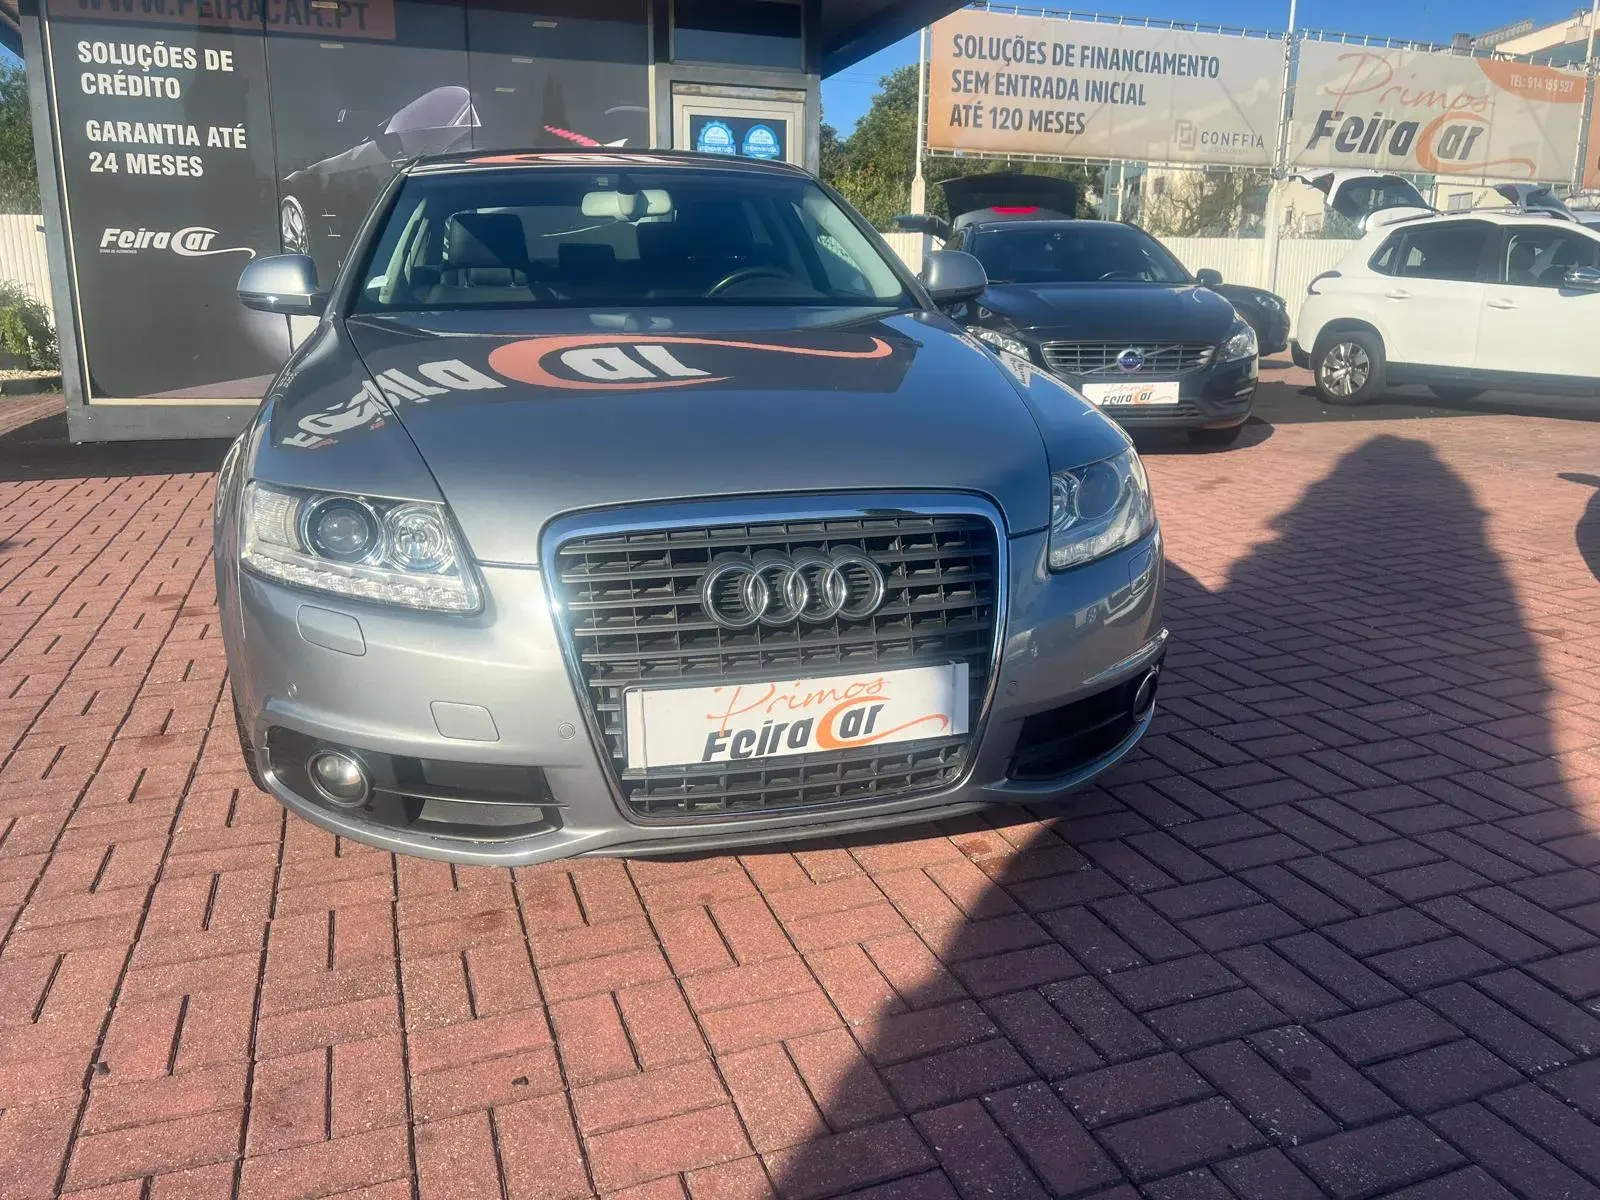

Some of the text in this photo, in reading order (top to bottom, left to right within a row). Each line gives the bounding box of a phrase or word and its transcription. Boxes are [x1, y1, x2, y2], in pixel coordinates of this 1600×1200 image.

[78, 40, 234, 72] SOLUÇÕES DE
[952, 33, 1220, 79] SOLUÇÕES DE FINANCIAMENTO
[81, 69, 181, 99] CRÉDITO
[951, 69, 1147, 106] SEM ENTRADA INICIAL
[1323, 52, 1495, 120] Primos
[950, 100, 1086, 135] ATÉ 120 MESES
[86, 120, 247, 149] GARANTIA ATÉ
[1200, 131, 1265, 149] CONFFIA
[89, 151, 204, 177] 24 MESES
